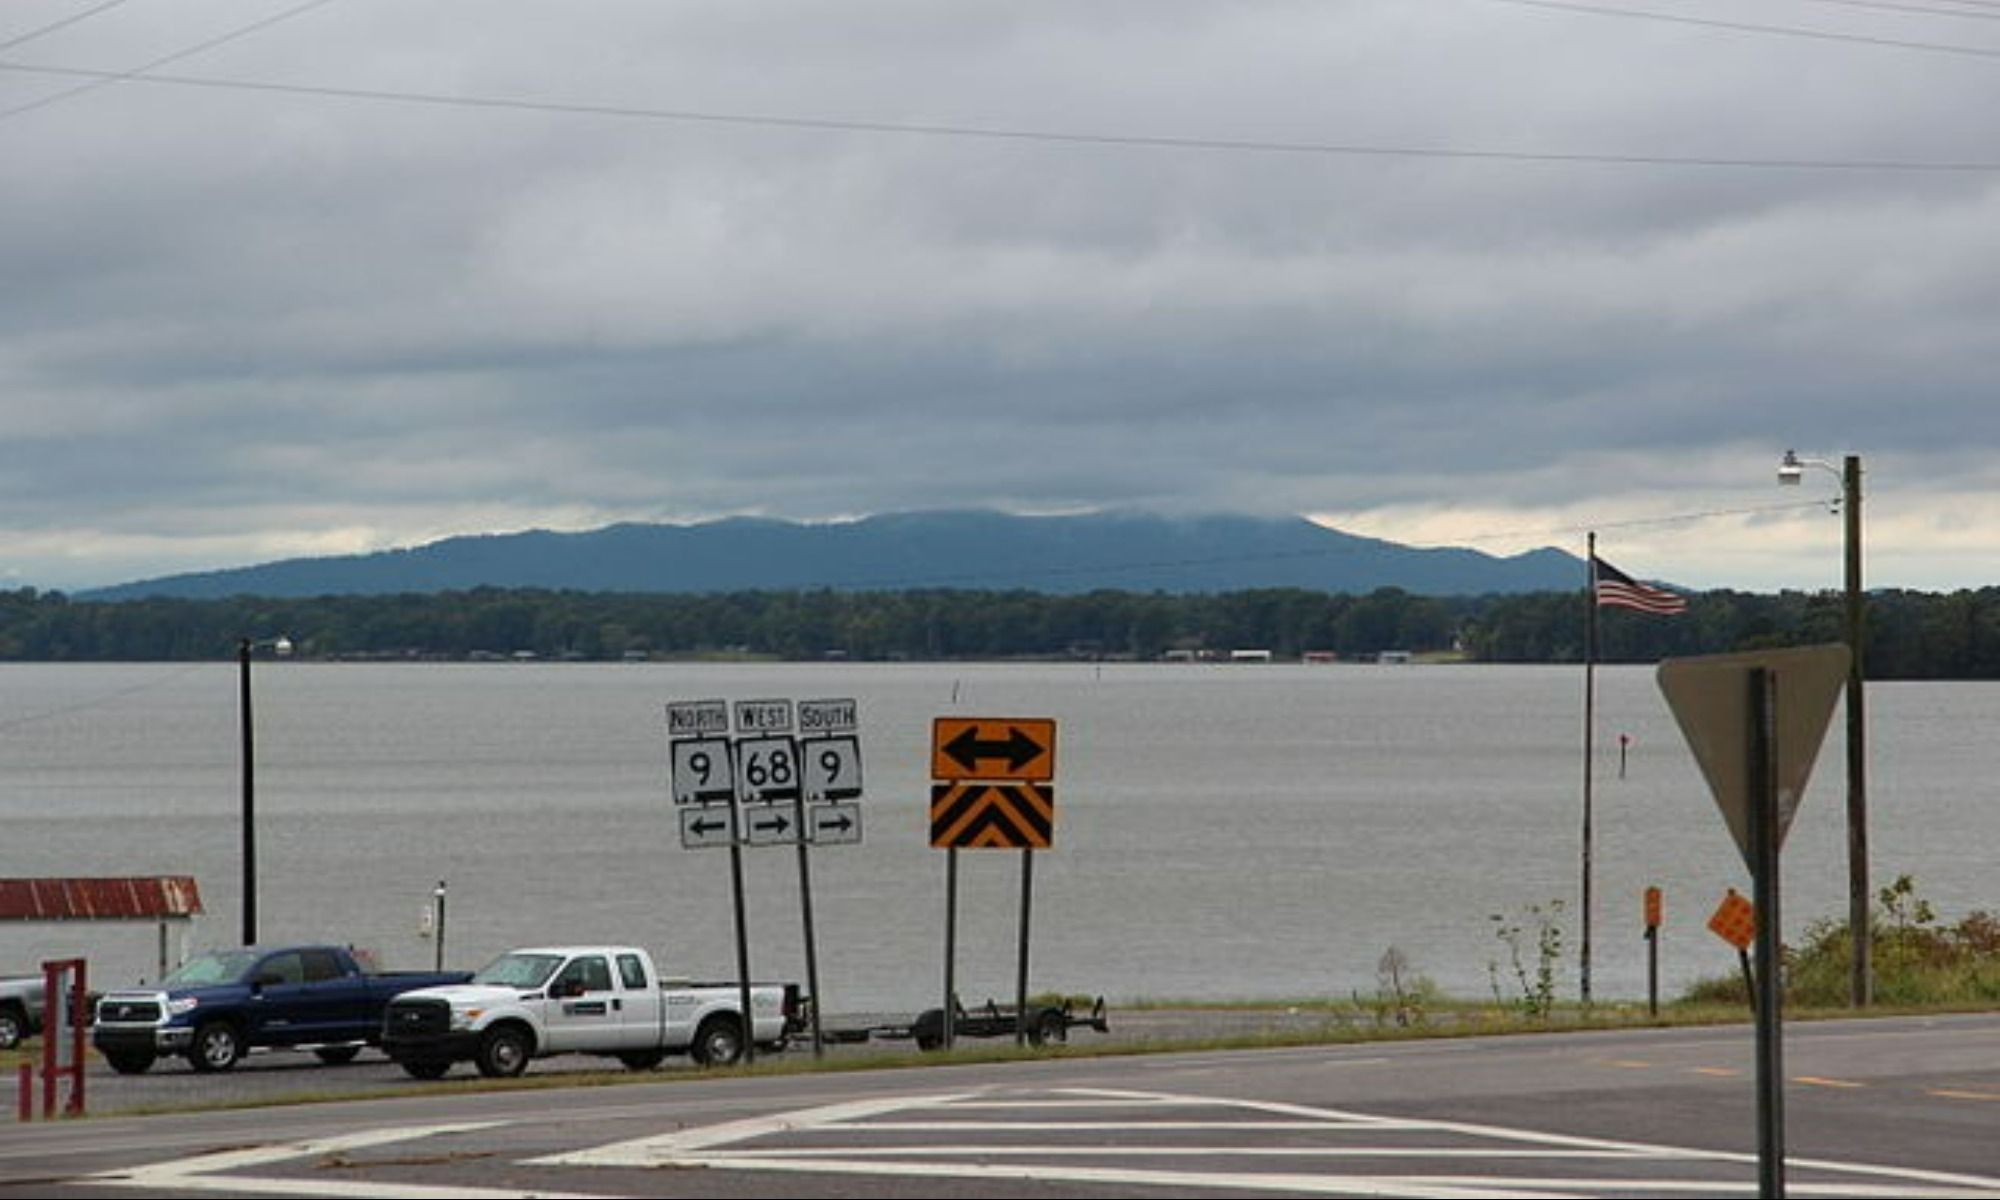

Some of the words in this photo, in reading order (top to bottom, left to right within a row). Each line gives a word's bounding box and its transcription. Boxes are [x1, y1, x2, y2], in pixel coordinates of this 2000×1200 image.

[670, 708, 727, 728] NORTH
[740, 706, 786, 727] WEST
[802, 706, 855, 727] SOUTH
[690, 752, 711, 786] 9
[748, 750, 792, 786] 68
[820, 750, 841, 784] 9
